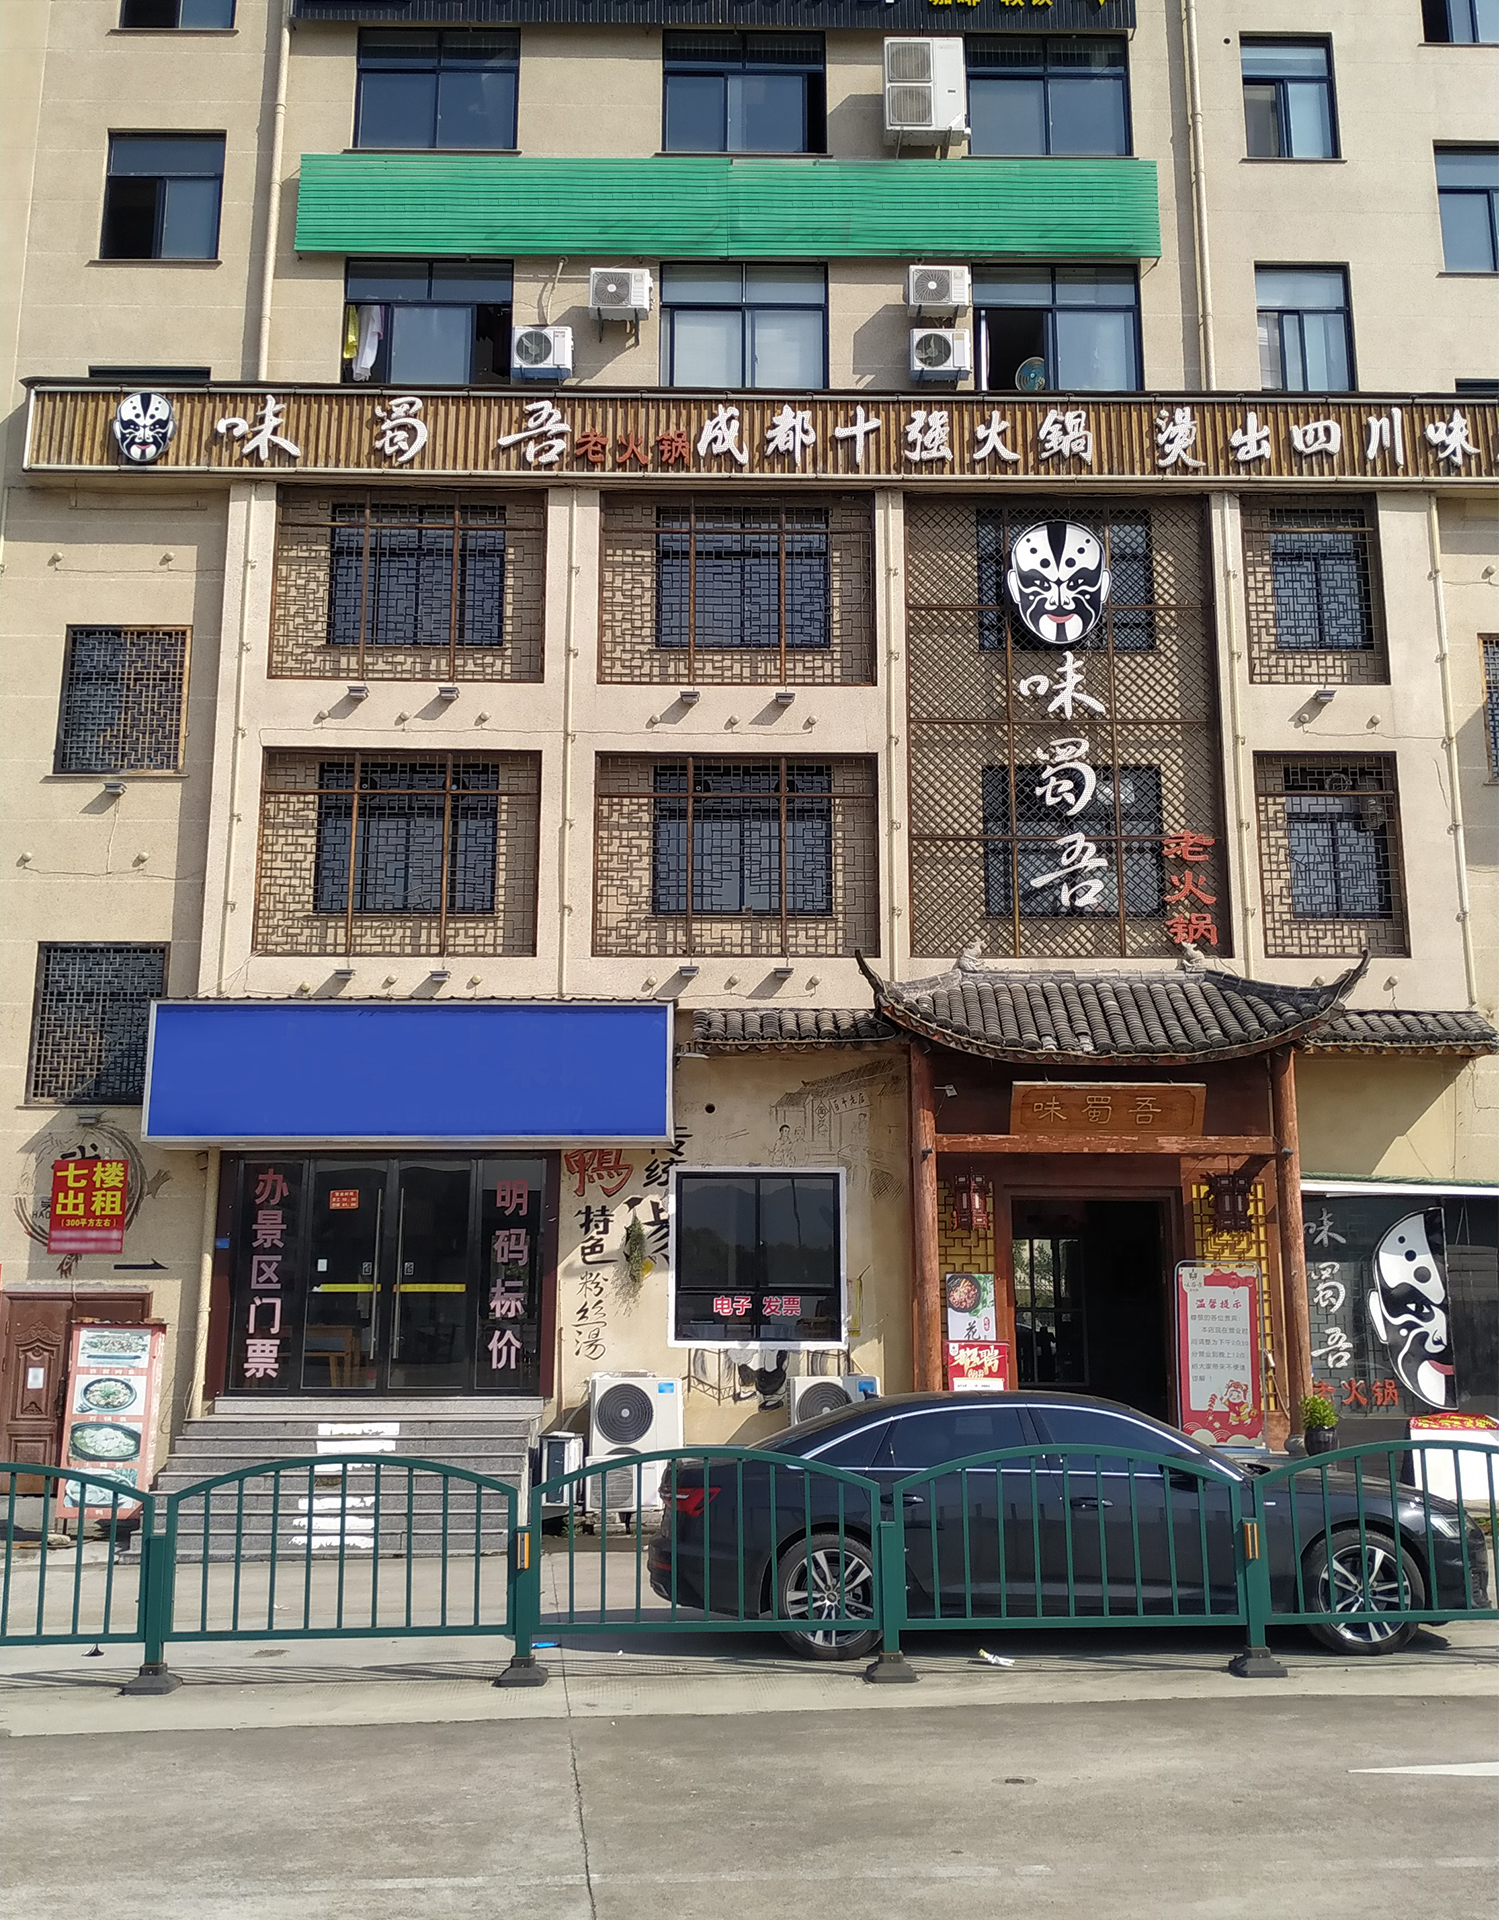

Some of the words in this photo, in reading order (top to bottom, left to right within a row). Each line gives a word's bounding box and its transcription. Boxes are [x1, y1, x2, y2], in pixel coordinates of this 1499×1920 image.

[217, 395, 572, 465] 味蜀吾
[576, 428, 690, 466] 老火锅
[1019, 651, 1109, 908] 味蜀吾
[1162, 829, 1219, 945] 老火锅
[1033, 1095, 1163, 1125] 味蜀吾
[56, 1162, 125, 1188] 七楼
[56, 1190, 123, 1216] 出租
[243, 1168, 290, 1378] 办景区门票
[488, 1179, 529, 1370] 明码标价
[713, 1295, 753, 1316] 电子
[762, 1295, 802, 1316] 发票
[1195, 1299, 1242, 1309] 温馨提示
